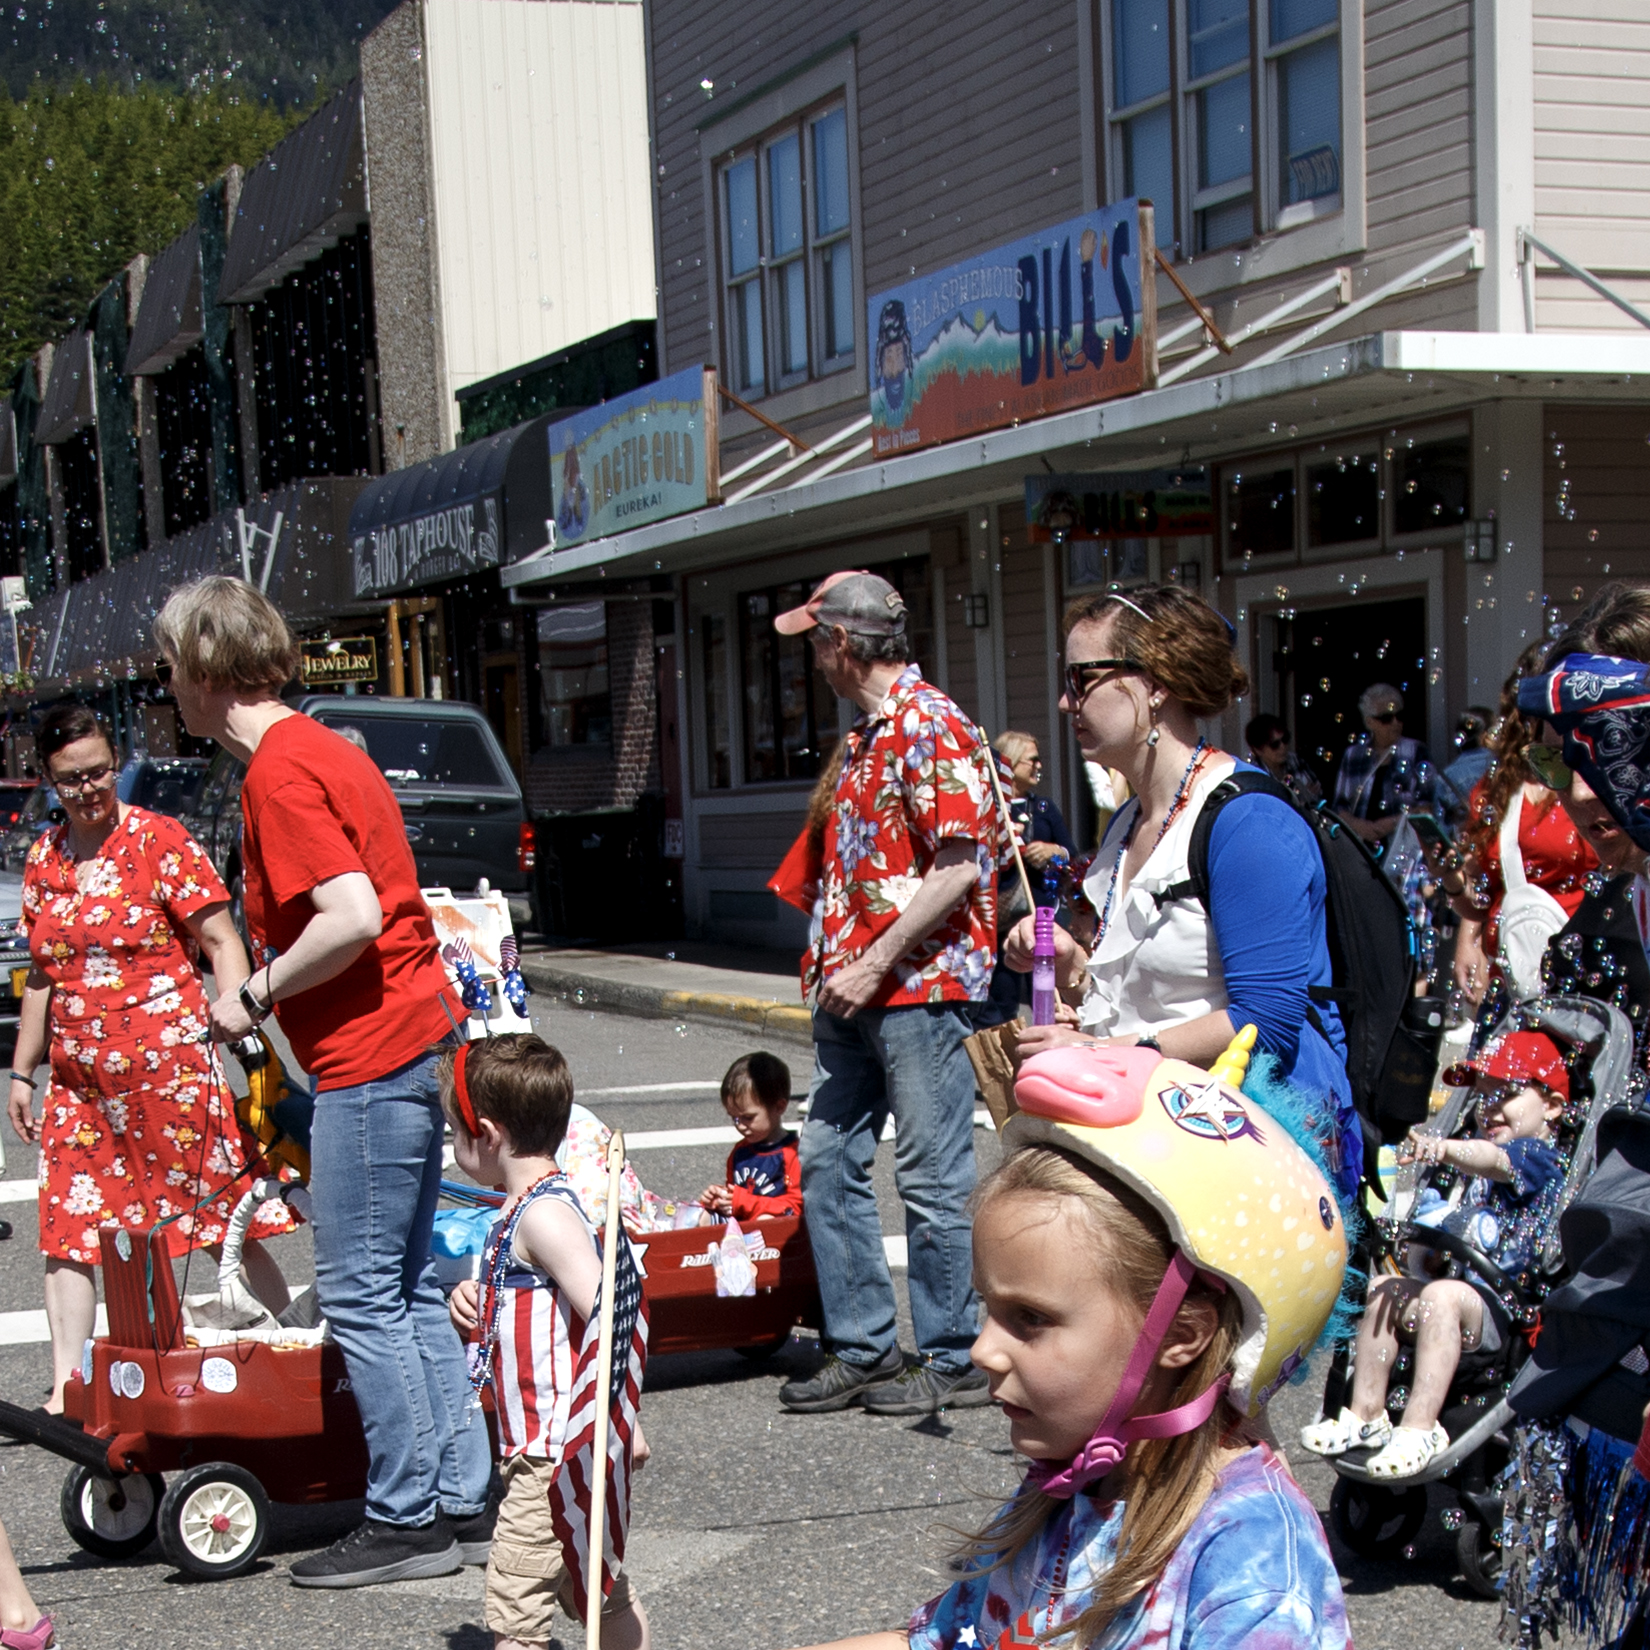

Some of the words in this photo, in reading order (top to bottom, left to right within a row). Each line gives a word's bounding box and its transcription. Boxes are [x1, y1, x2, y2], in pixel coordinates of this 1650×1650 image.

[912, 266, 1024, 336] BLASPHEMOUS
[593, 433, 649, 517] ARCTIC
[652, 430, 695, 487] GOLD
[615, 491, 663, 518] EUREKA!
[375, 526, 399, 588] 108
[398, 504, 477, 581] TAPHOUSE
[303, 654, 372, 677] JEWELRY
